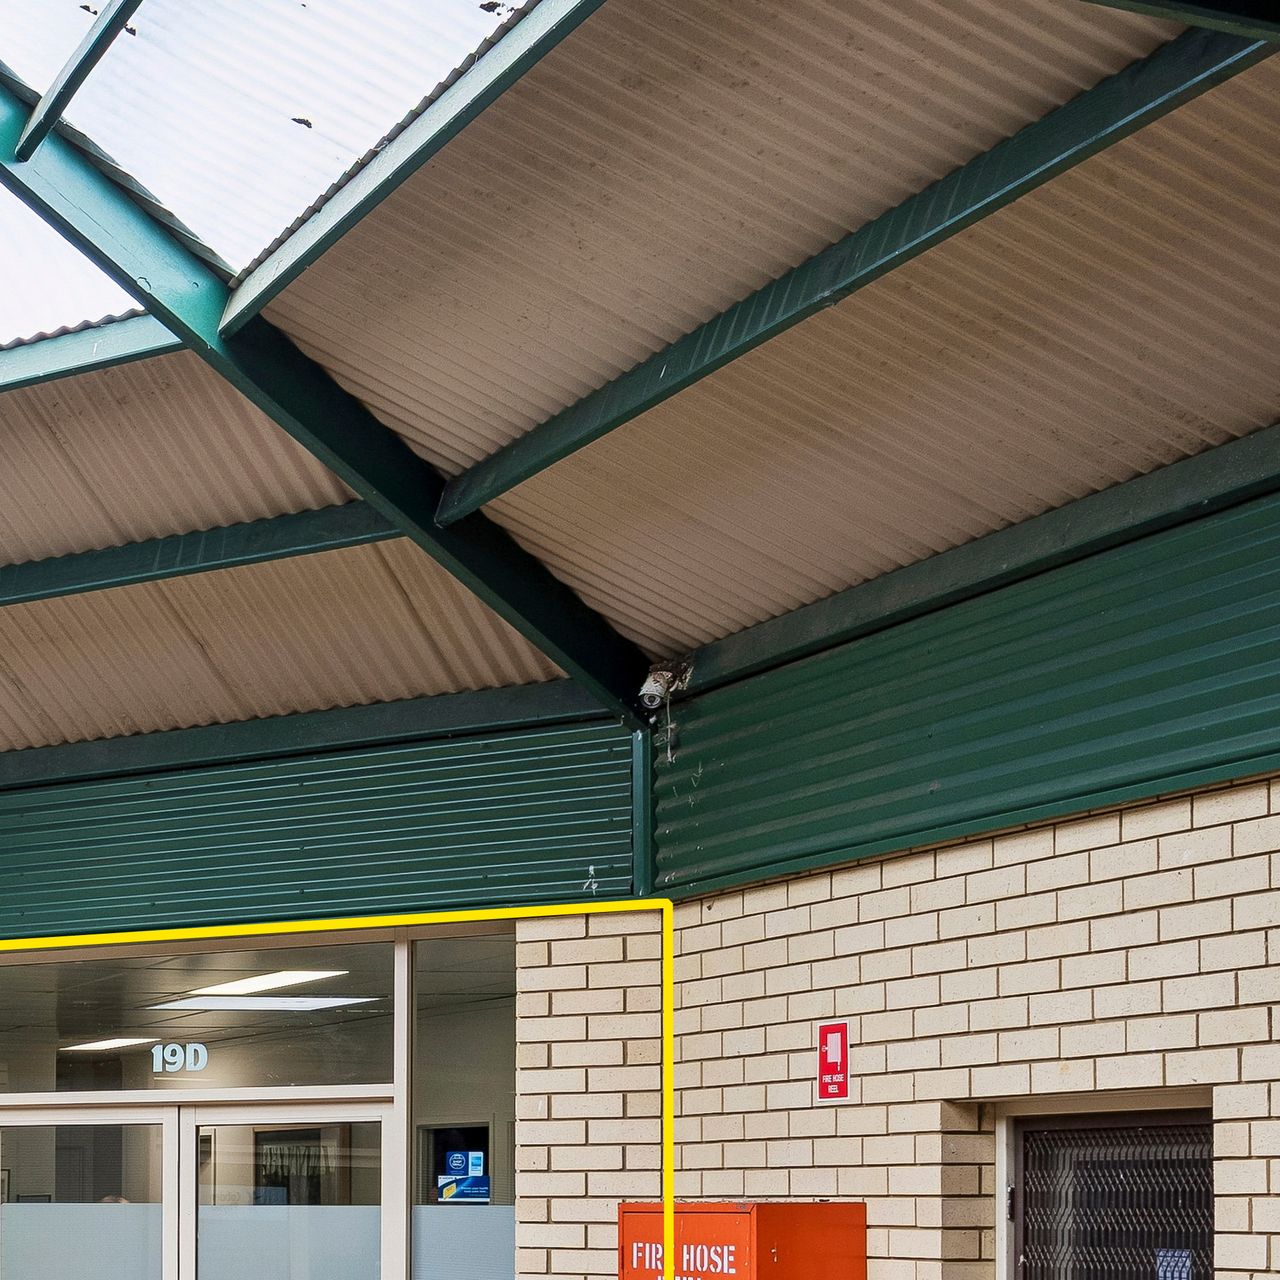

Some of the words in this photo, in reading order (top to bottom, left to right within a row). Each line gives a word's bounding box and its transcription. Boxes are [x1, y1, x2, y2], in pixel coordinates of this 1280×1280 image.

[151, 1043, 209, 1073] 19D
[822, 1074, 833, 1083] FIRE
[632, 1242, 675, 1271] FIR
[682, 1244, 737, 1274] HOSE
